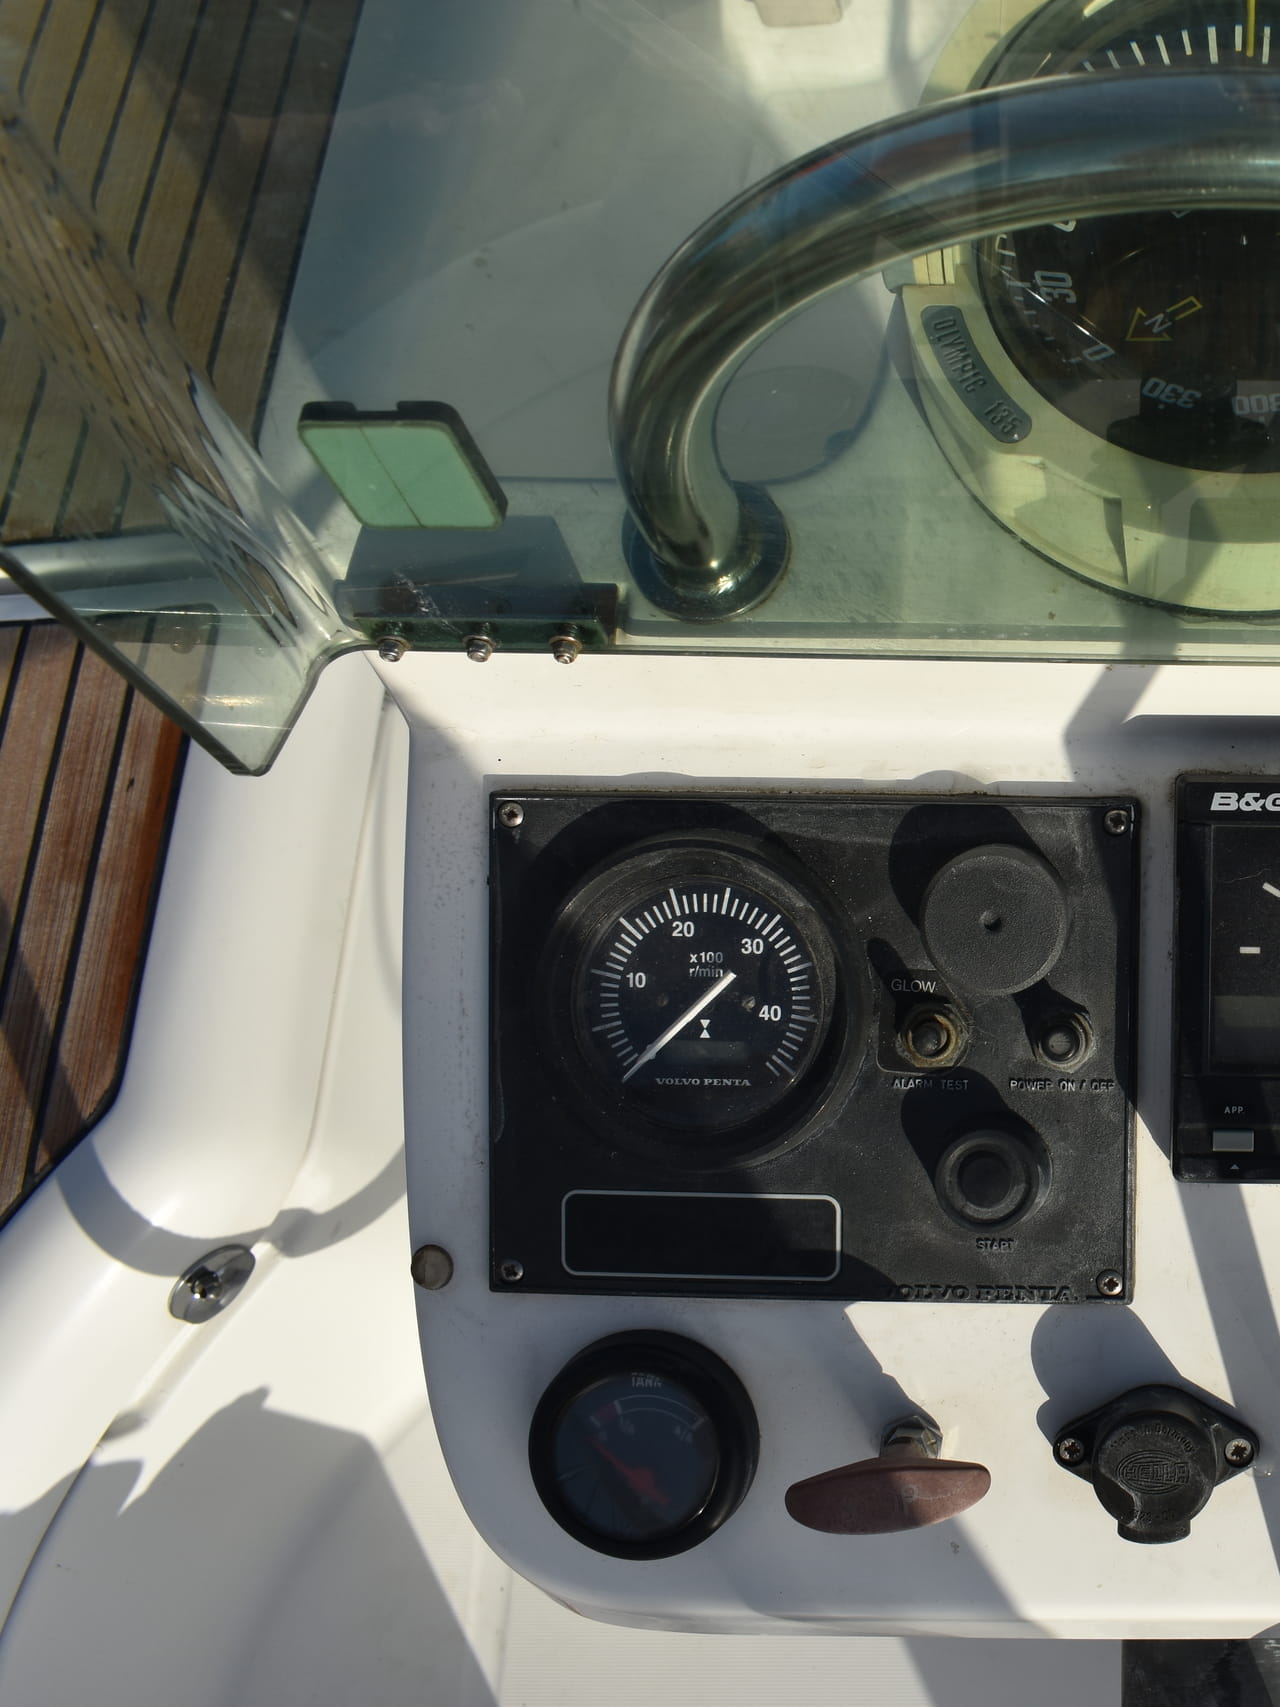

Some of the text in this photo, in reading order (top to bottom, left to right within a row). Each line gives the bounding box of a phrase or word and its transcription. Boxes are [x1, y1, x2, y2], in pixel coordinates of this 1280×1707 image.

[1034, 270, 1077, 304] 30
[1143, 313, 1173, 335] N
[934, 316, 1024, 435] OLYMPIC 135
[1141, 376, 1203, 409] 330
[672, 921, 695, 938] 20
[741, 938, 764, 955] 30
[689, 952, 723, 963] x100
[626, 972, 646, 988] 10
[689, 966, 724, 978] r/min
[891, 978, 936, 993] GLOW
[759, 1005, 782, 1021] 40
[656, 1077, 751, 1086] VOLVO PENTA
[892, 1077, 969, 1090] ALARM TEST
[1009, 1078, 1053, 1091] POWER
[1058, 1079, 1076, 1091] ON
[1224, 1106, 1244, 1115] APP
[976, 1238, 1016, 1251] START
[880, 1285, 1078, 1302] VOLVO PENTA
[1124, 1462, 1191, 1485] HELLA
